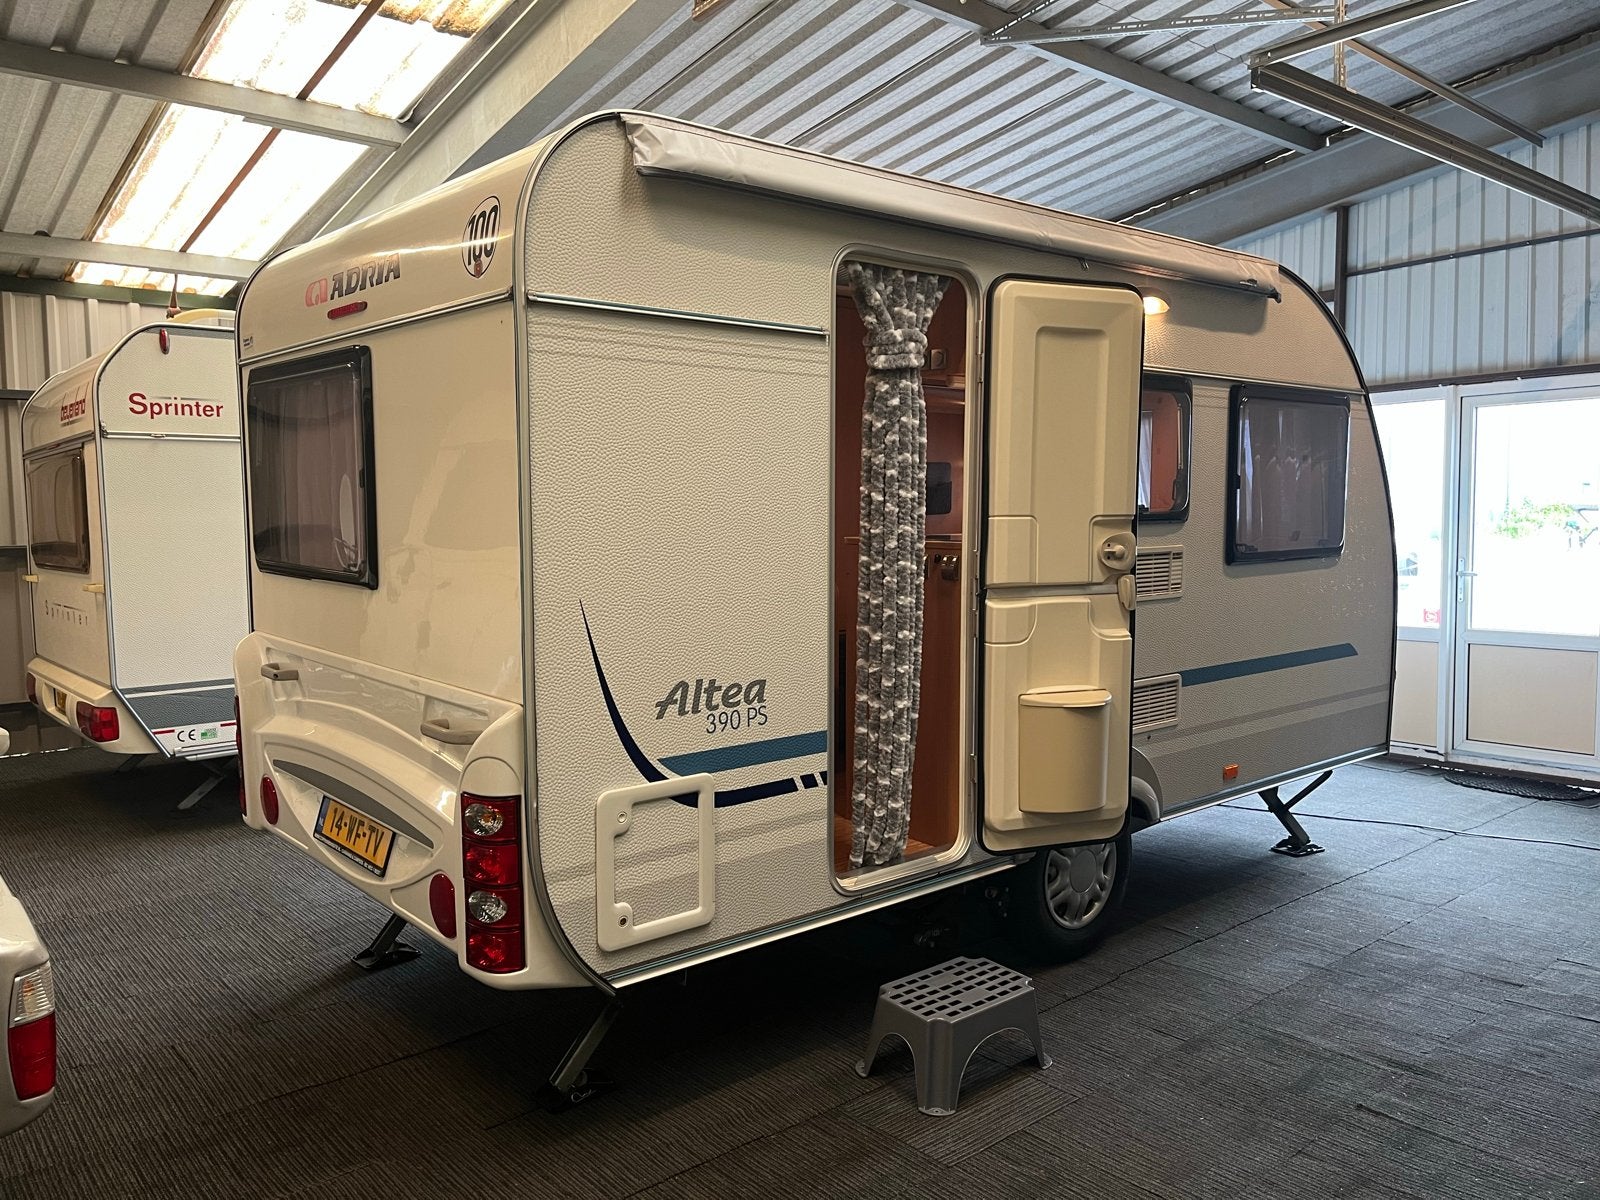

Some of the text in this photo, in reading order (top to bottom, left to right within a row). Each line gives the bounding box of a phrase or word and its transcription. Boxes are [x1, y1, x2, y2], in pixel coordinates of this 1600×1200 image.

[467, 204, 500, 266] 100
[330, 252, 401, 301] ADRIA
[128, 392, 224, 419] Sprinter
[655, 678, 768, 720] Altea
[706, 705, 768, 734] 390 PS
[176, 728, 196, 742] CE
[330, 807, 385, 857] 14-WF-TV
